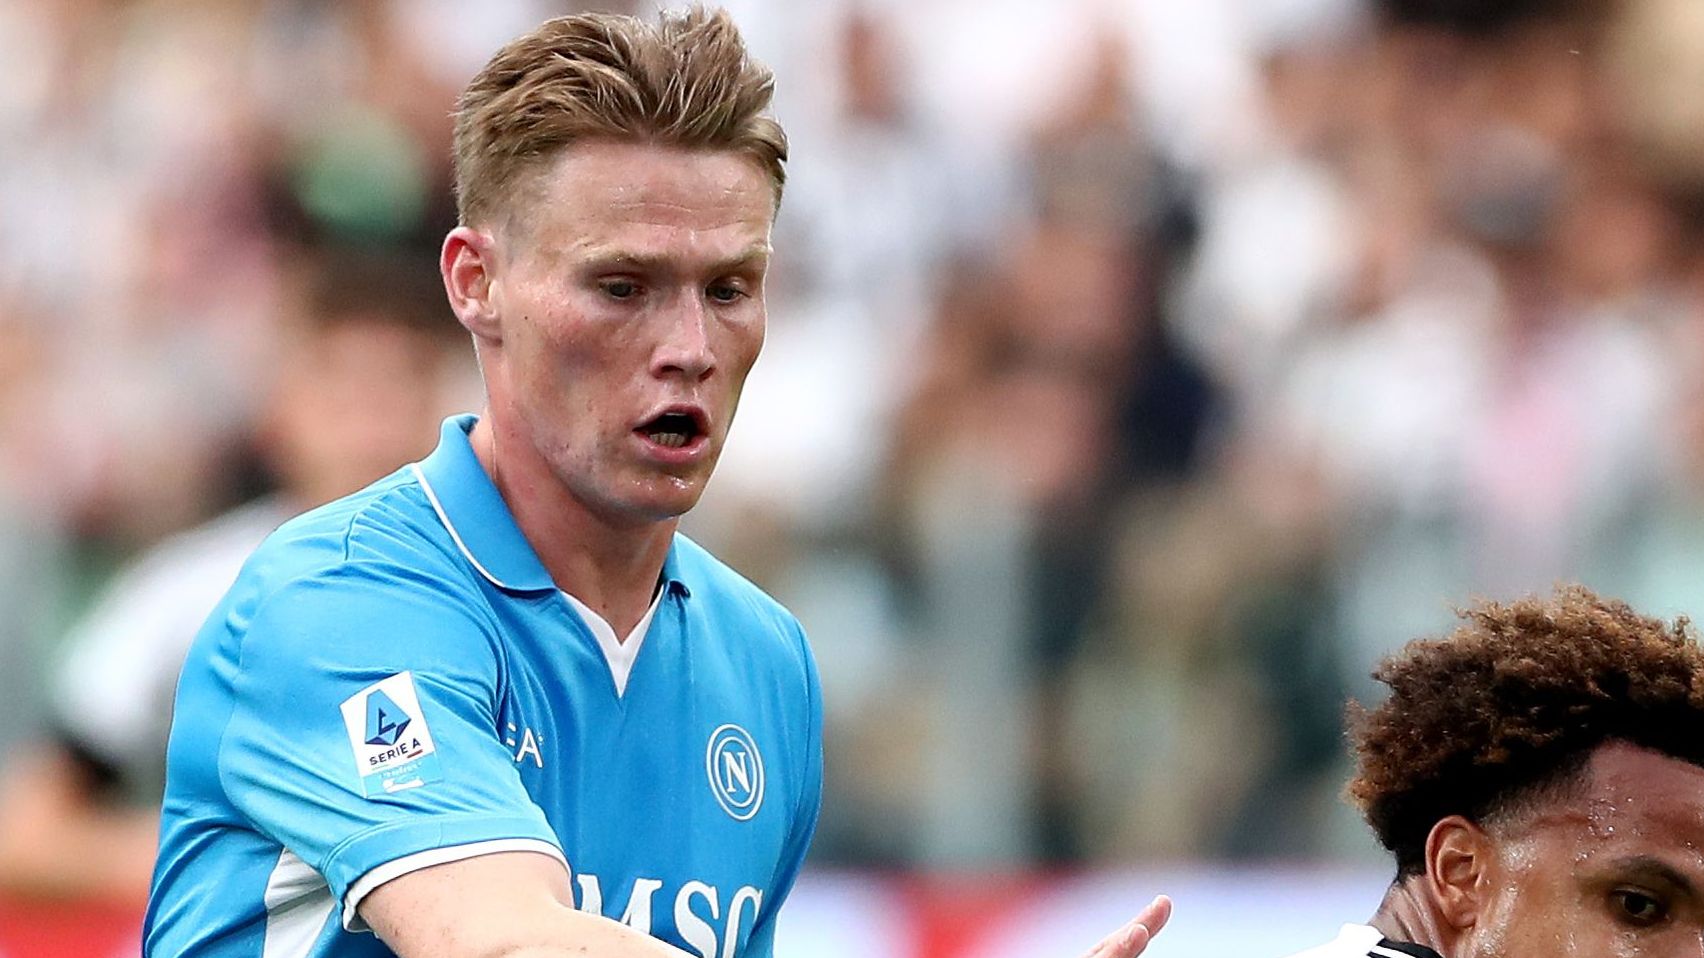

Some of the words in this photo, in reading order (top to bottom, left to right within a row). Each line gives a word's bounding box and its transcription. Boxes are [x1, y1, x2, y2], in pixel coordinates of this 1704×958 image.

[368, 742, 410, 767] SERIE
[411, 737, 422, 750] A
[721, 750, 752, 794] N
